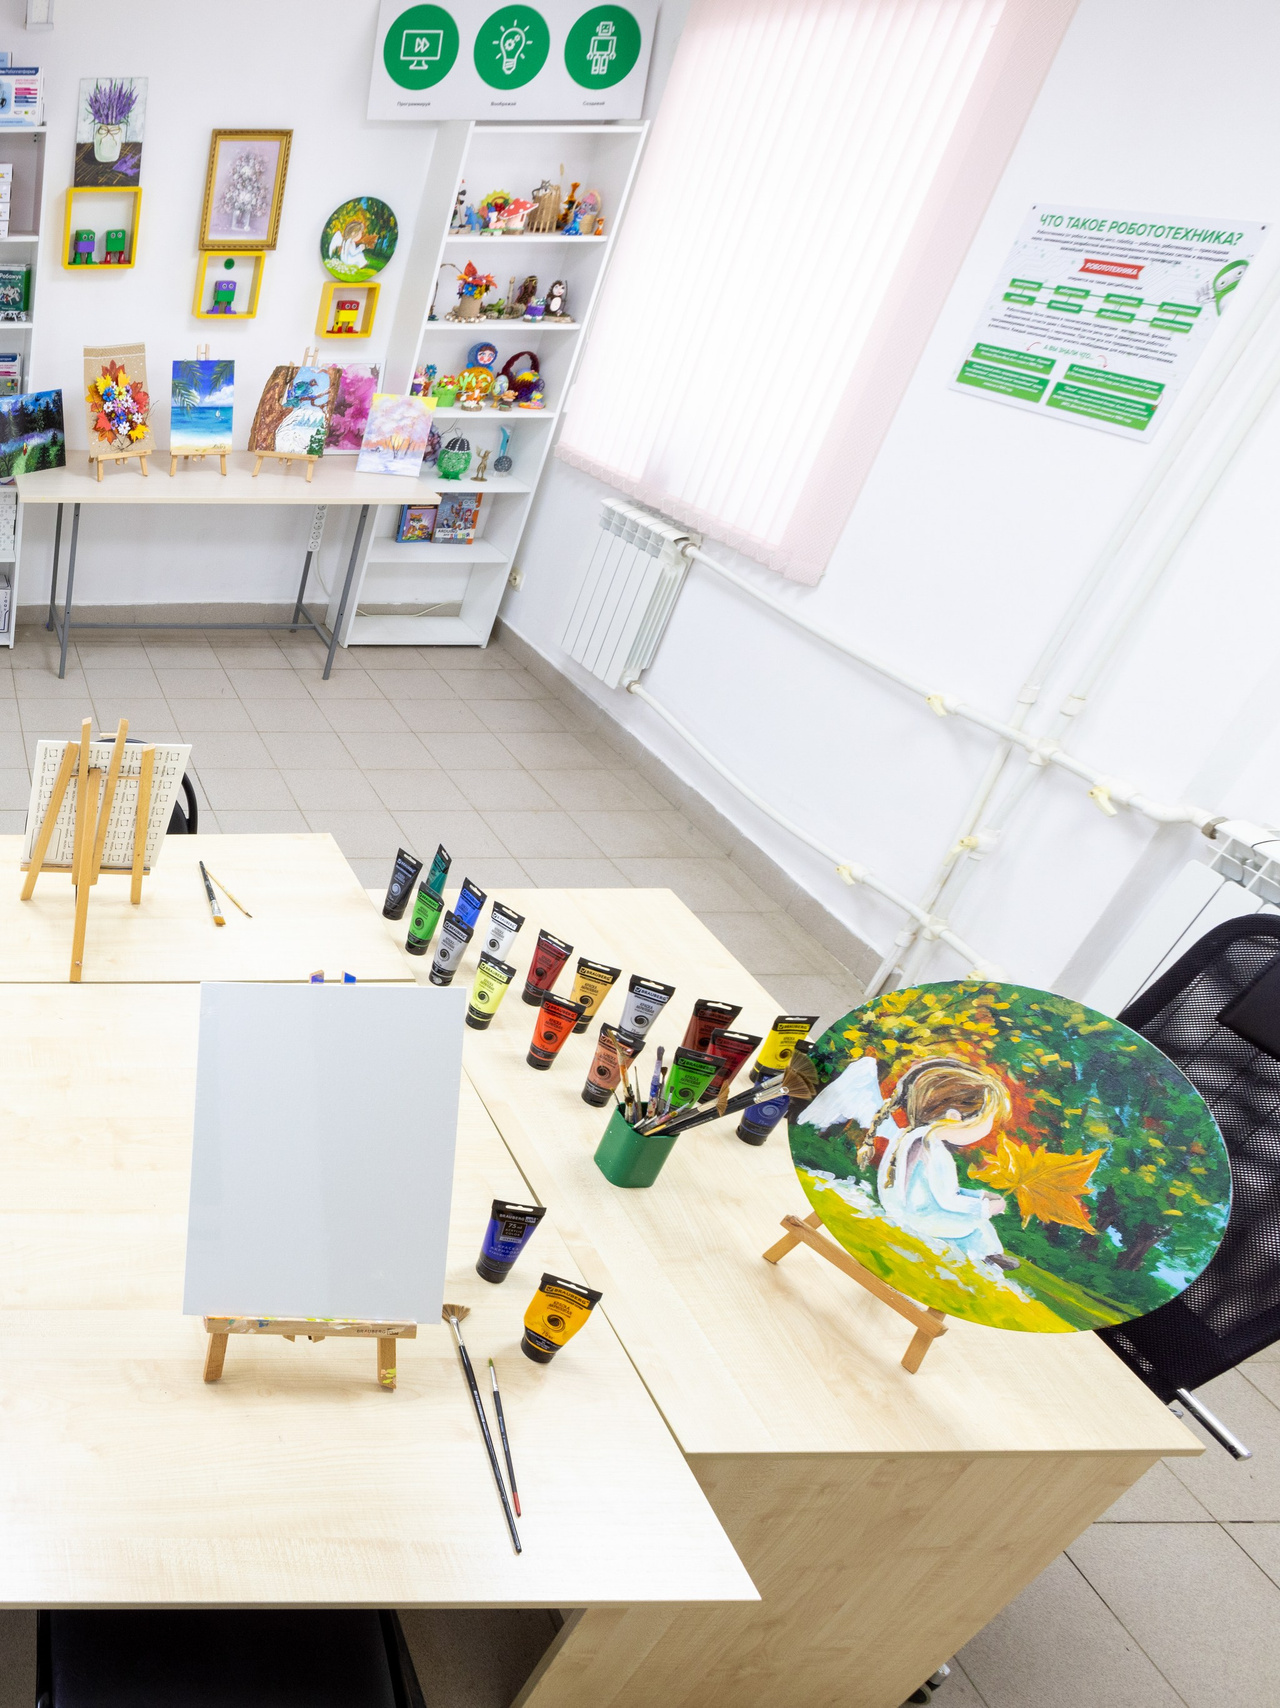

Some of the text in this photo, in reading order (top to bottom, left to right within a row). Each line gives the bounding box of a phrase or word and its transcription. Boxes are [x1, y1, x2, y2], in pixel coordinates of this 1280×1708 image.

[1040, 213, 1064, 228] ЧТО
[1066, 216, 1108, 232] ТАКОЕ
[1107, 220, 1244, 246] РОБОТОТЕХНИКА?
[1084, 261, 1138, 275] РОБОТОТЕХНИКА
[448, 923, 467, 940] BRAUBERG
[485, 965, 507, 981] BRAUBERG
[585, 969, 611, 981] BRAUBERG
[640, 989, 668, 1001] BRAUBERG
[549, 1003, 577, 1018] BRAUBERG
[685, 1061, 716, 1073] BRAUBERG
[554, 1288, 587, 1304] BRAUBERG
